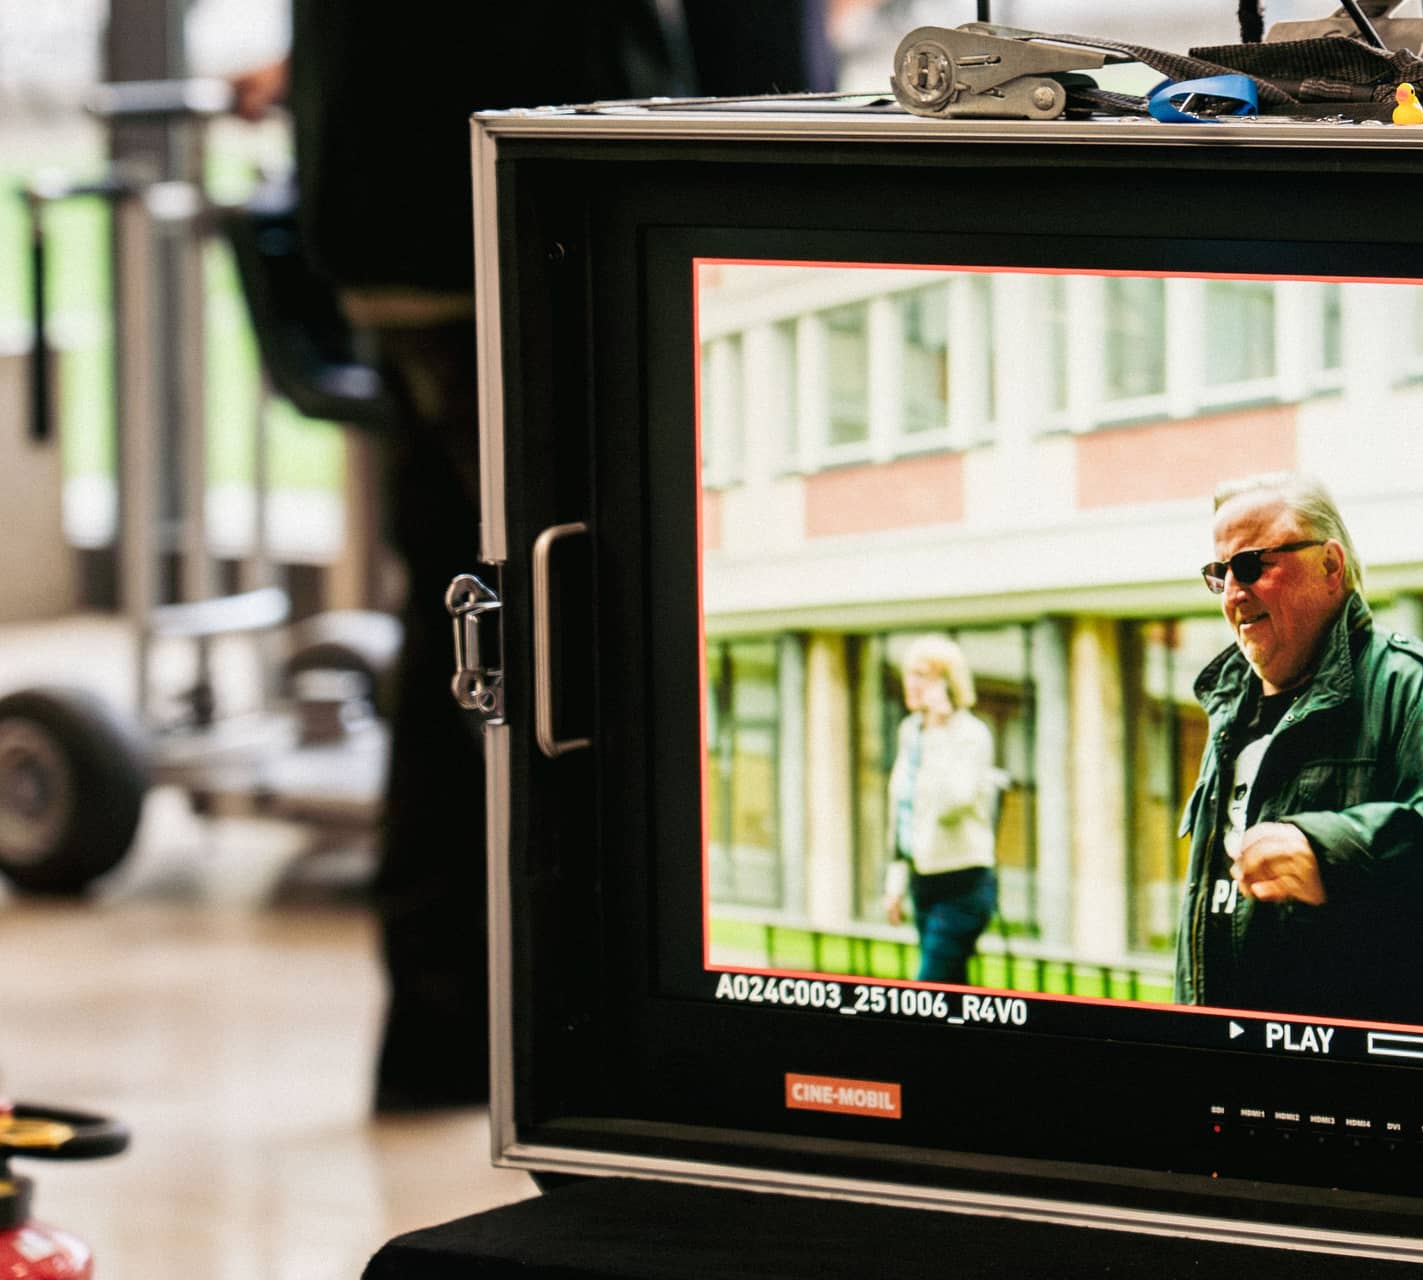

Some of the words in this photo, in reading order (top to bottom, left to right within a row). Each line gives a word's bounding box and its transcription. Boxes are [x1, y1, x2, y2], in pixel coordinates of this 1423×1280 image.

[715, 973, 1028, 1026] A024C003_251006_R4V0
[1265, 1022, 1335, 1054] PLAY
[791, 1082, 896, 1111] CINE-MOBIL
[1240, 1108, 1265, 1118] HDMI1
[1274, 1111, 1300, 1122] HDMI2
[1309, 1115, 1336, 1125] HDMI3
[1345, 1118, 1371, 1128] HDMI4
[1386, 1122, 1401, 1131] DVI
